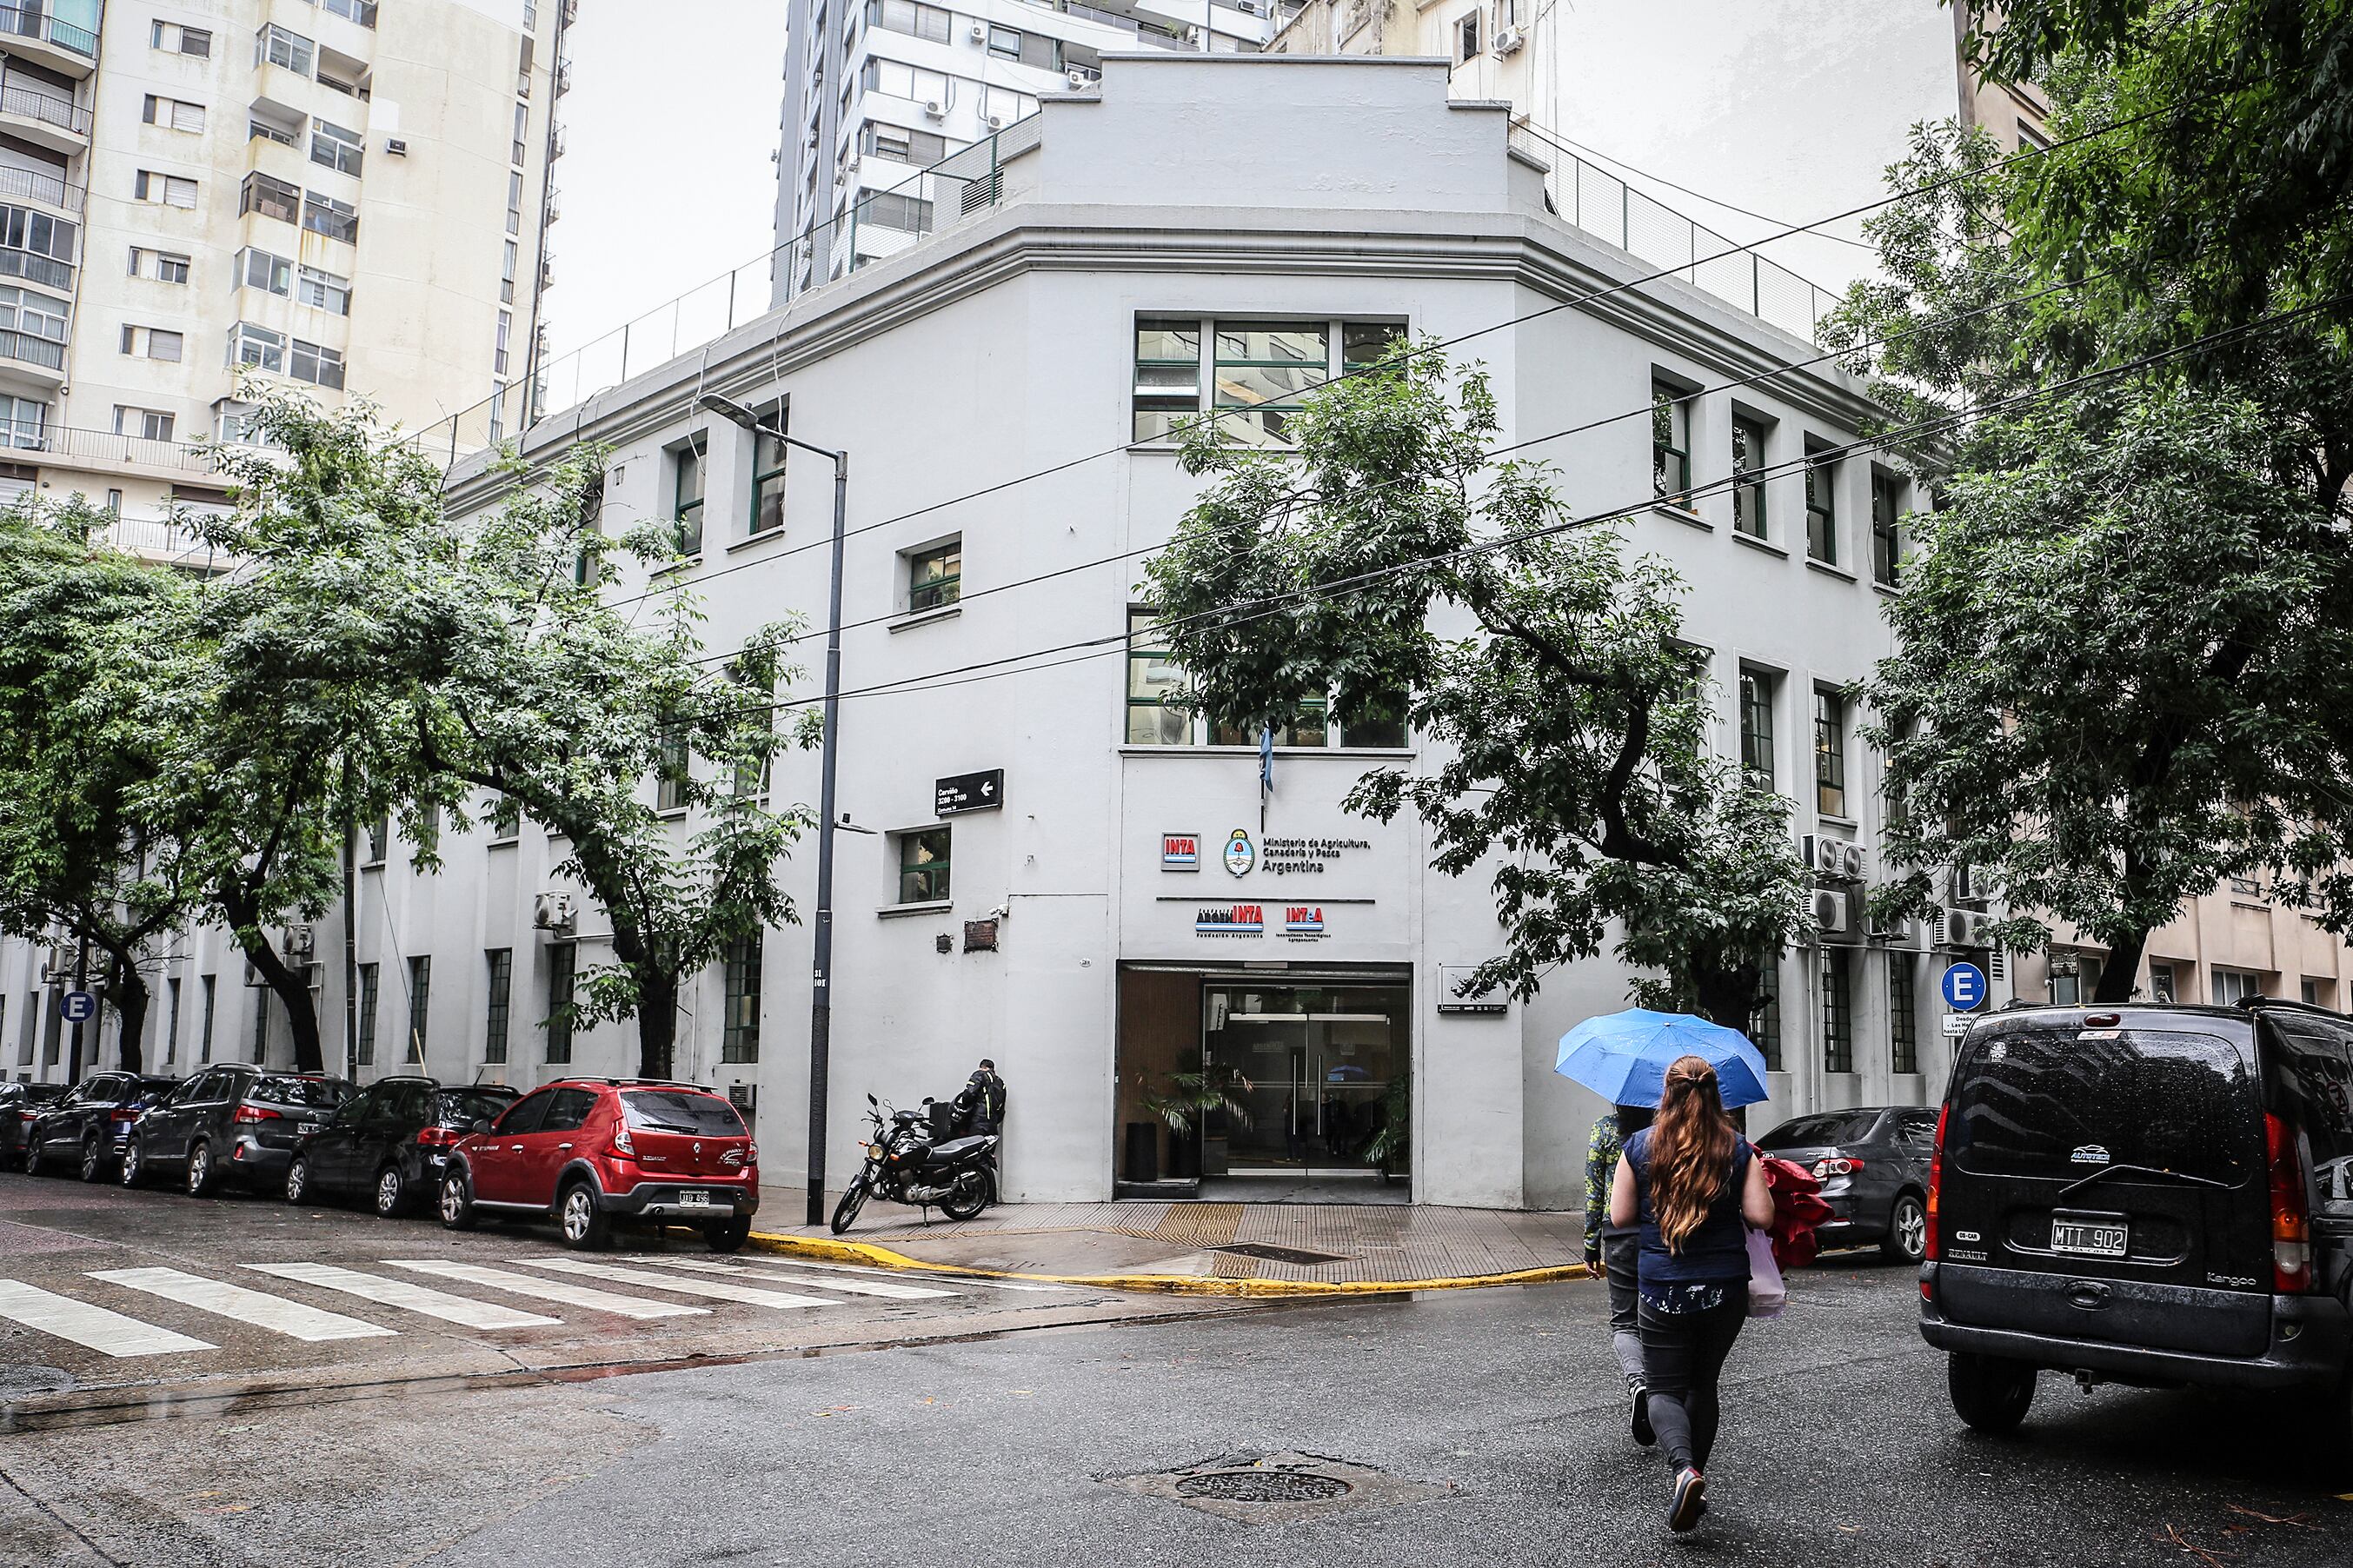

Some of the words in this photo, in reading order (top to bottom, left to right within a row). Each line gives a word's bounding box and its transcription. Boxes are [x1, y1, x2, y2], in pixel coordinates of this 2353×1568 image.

[1166, 839, 1196, 855] INTA
[1263, 837, 1306, 848] Ministerio
[1308, 838, 1319, 848] de
[1320, 839, 1371, 850] Agricultura,
[1263, 847, 1306, 858] Ganadería
[1307, 849, 1313, 860] y
[1315, 847, 1341, 859] Pesca
[1261, 860, 1325, 875] Argentina
[1953, 972, 1974, 1001] E
[70, 996, 86, 1018] E
[2054, 1226, 2084, 1246] MTT
[2093, 1229, 2124, 1250] 902
[2207, 1272, 2257, 1286] Kangoo
